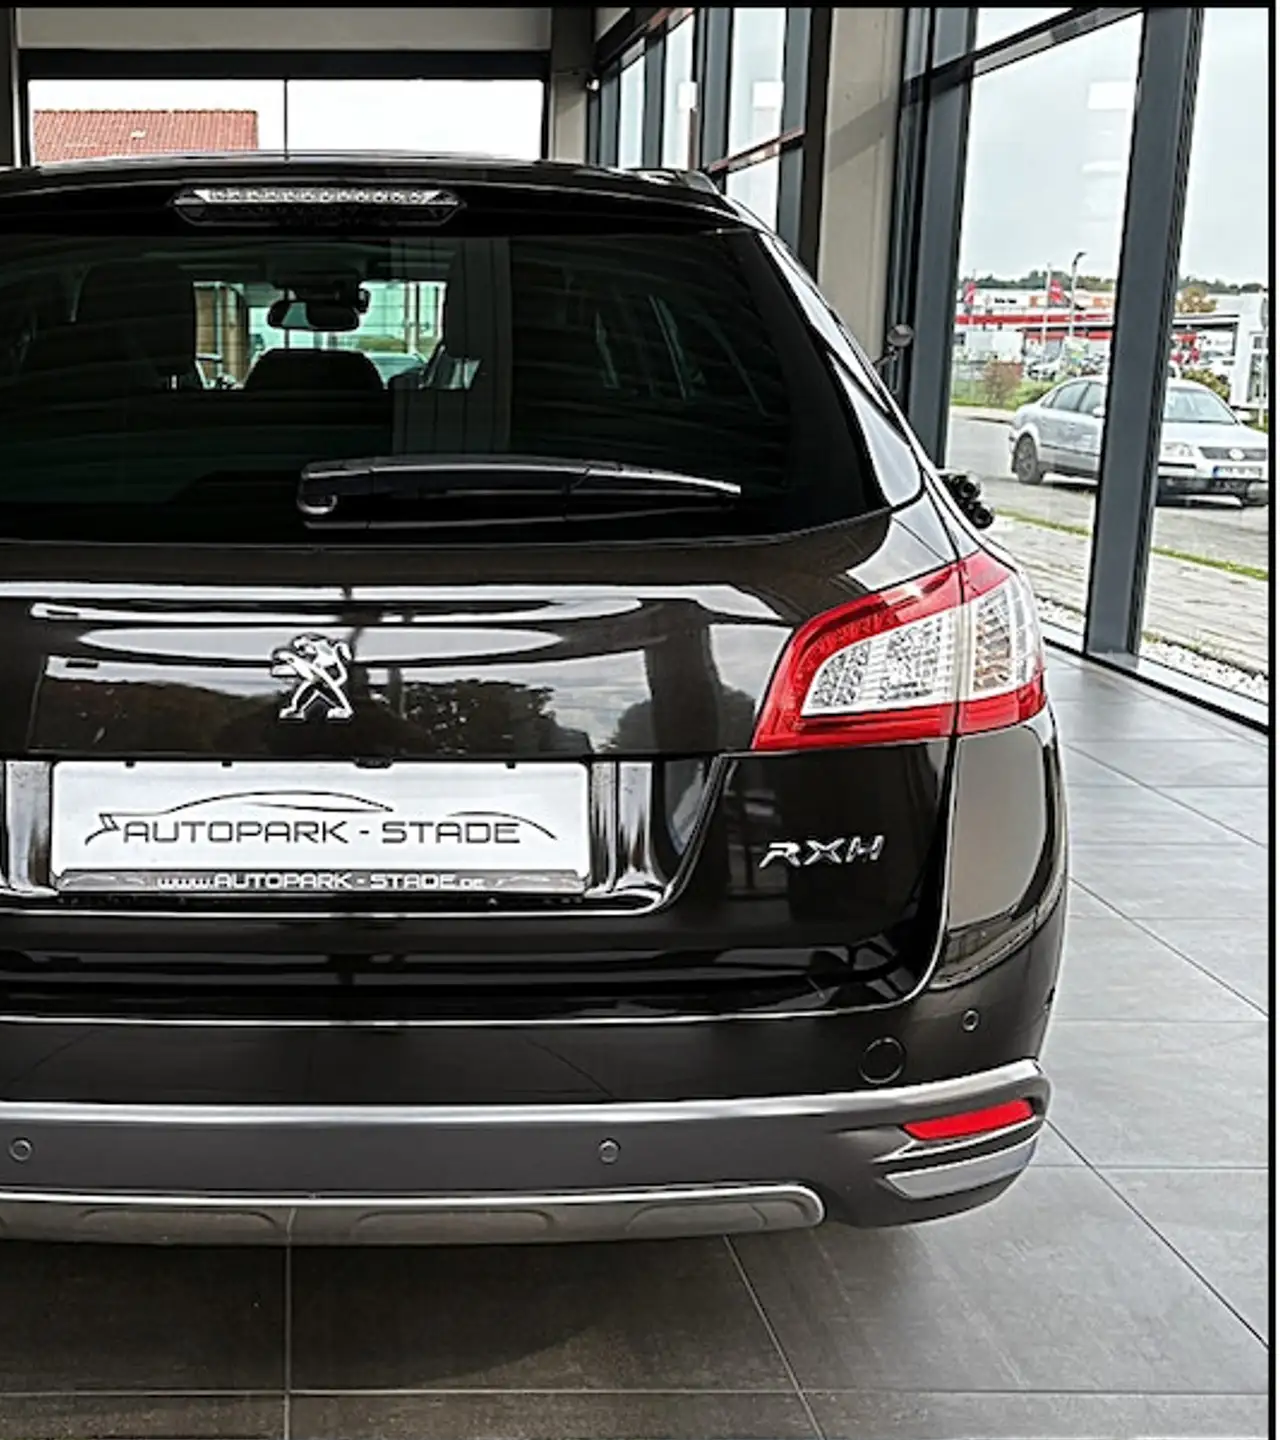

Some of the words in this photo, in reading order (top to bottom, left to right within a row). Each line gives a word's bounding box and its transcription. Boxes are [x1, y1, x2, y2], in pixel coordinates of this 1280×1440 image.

[122, 820, 350, 844] AUTOPARK
[381, 820, 521, 844] STADE
[758, 834, 885, 868] RXH
